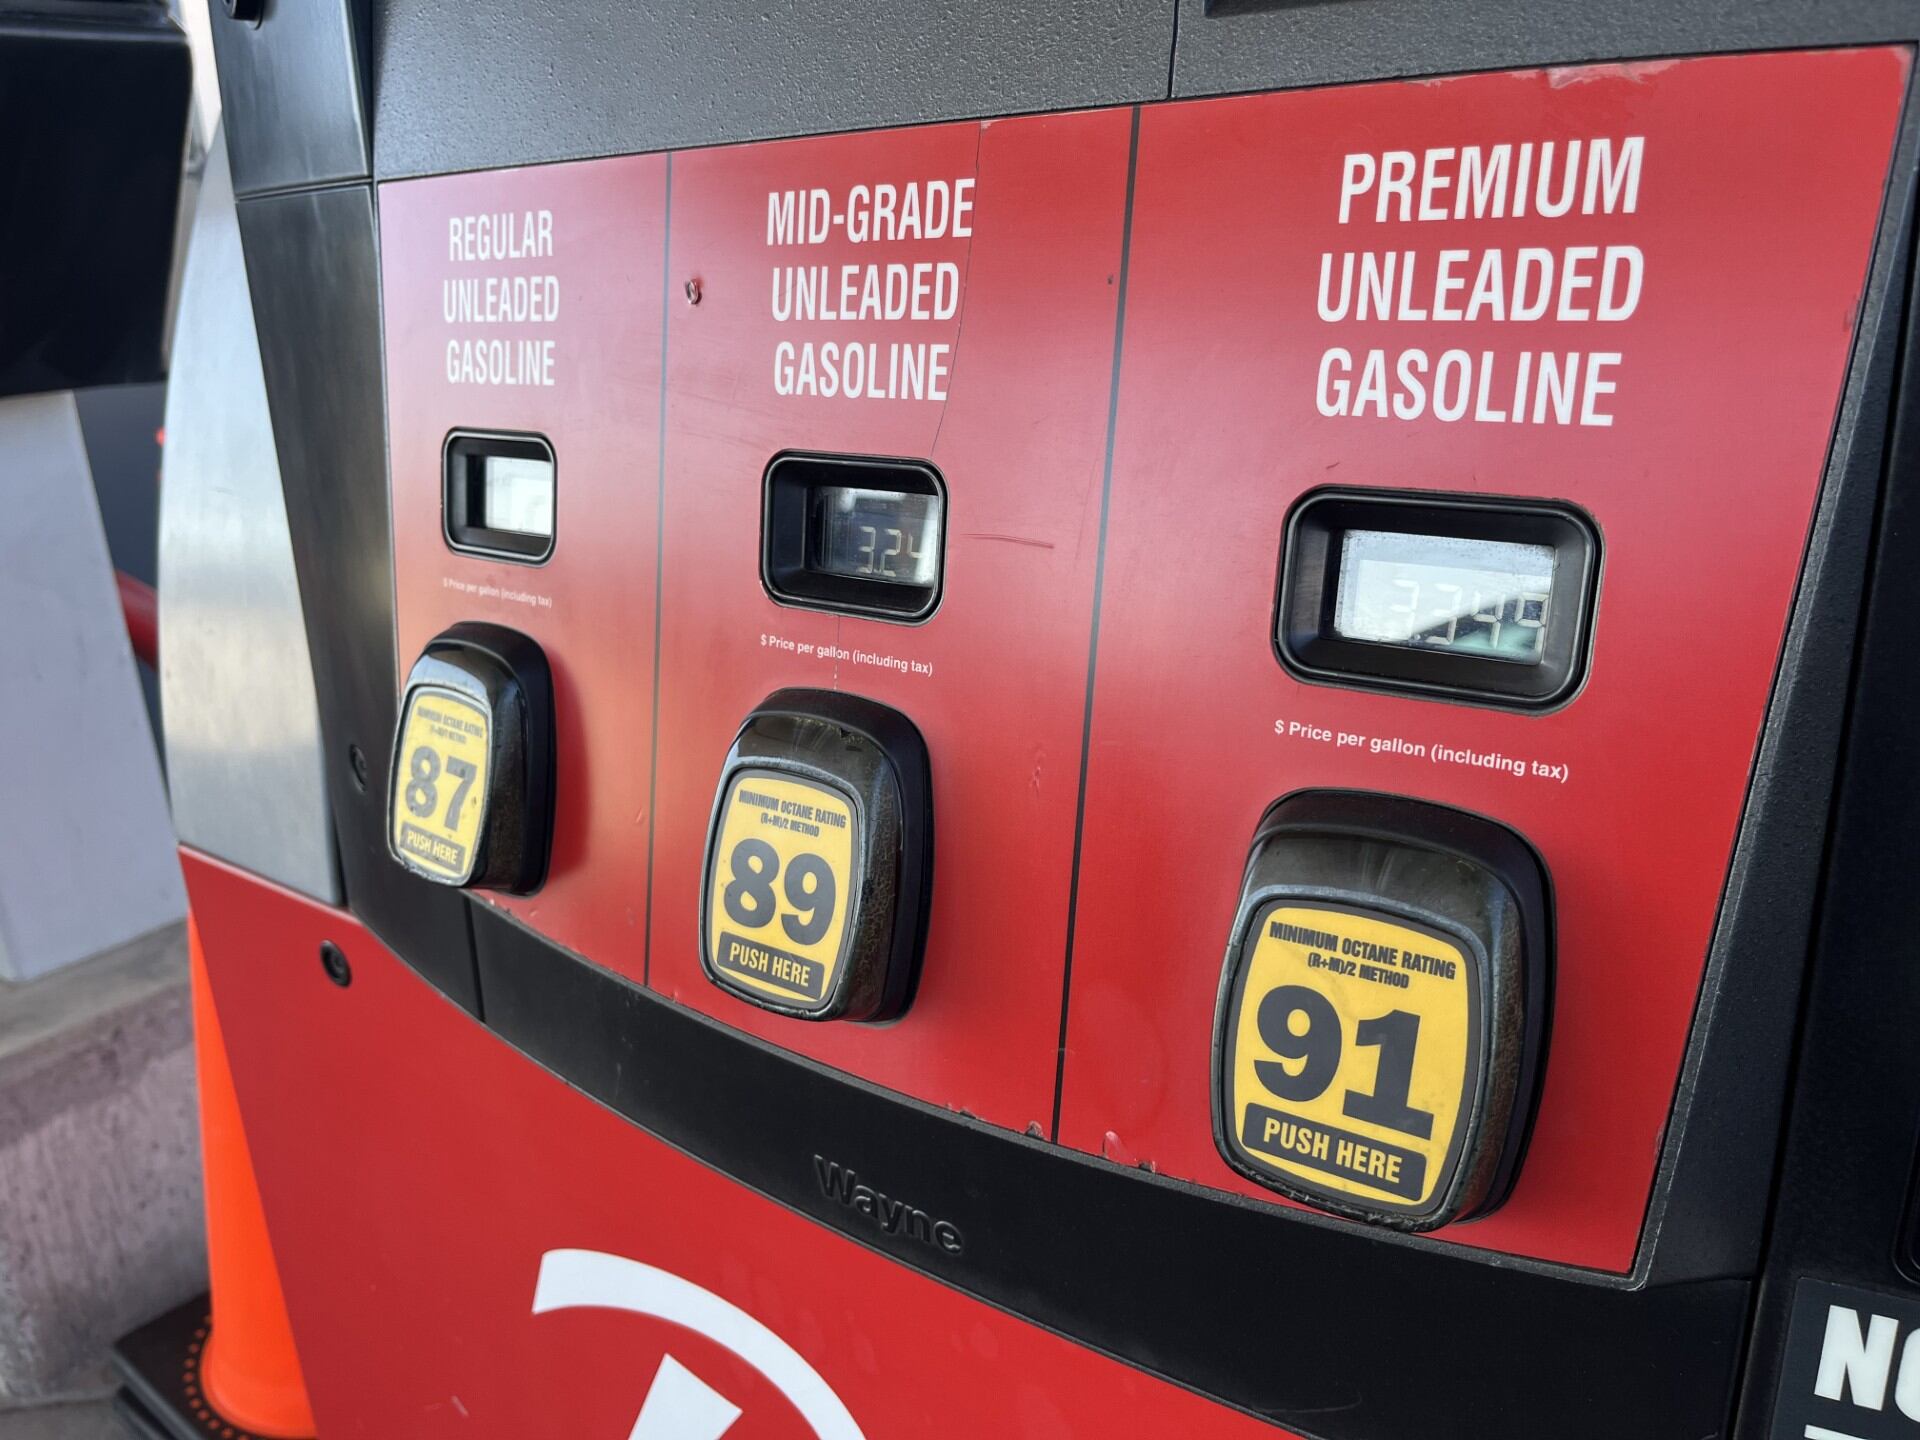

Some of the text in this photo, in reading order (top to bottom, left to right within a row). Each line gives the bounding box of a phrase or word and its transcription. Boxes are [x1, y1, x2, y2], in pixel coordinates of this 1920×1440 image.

[1338, 136, 1645, 224] PREMIUM
[449, 209, 554, 261] REGULAR
[767, 178, 976, 246] MID-GRADE
[443, 275, 560, 323] UNLEADED
[771, 262, 960, 322] UNLEADED
[1316, 246, 1644, 322] UNLEADED
[446, 339, 556, 386] GASOLINE
[773, 341, 950, 401] GASOLINE
[1315, 347, 1622, 426] GASOLINE
[760, 634, 933, 677] $ Price per gallon (including tax)
[1274, 719, 1569, 783] $ Price per gallon (including tax)
[405, 746, 478, 833] 87
[781, 800, 814, 820] OCTANE
[815, 808, 847, 829] RATING
[407, 830, 458, 865] PUSH HERE
[789, 819, 820, 838] METHOD
[723, 838, 837, 946] 89
[729, 941, 812, 988] PUSH HERE
[1269, 921, 1456, 981] MINIMUM OCTANE RATING
[1307, 952, 1410, 989] (R+M)/2 METHOD
[1254, 984, 1434, 1141] 91
[1263, 1116, 1403, 1185] PUSH HERE
[813, 1154, 964, 1255] Wayne
